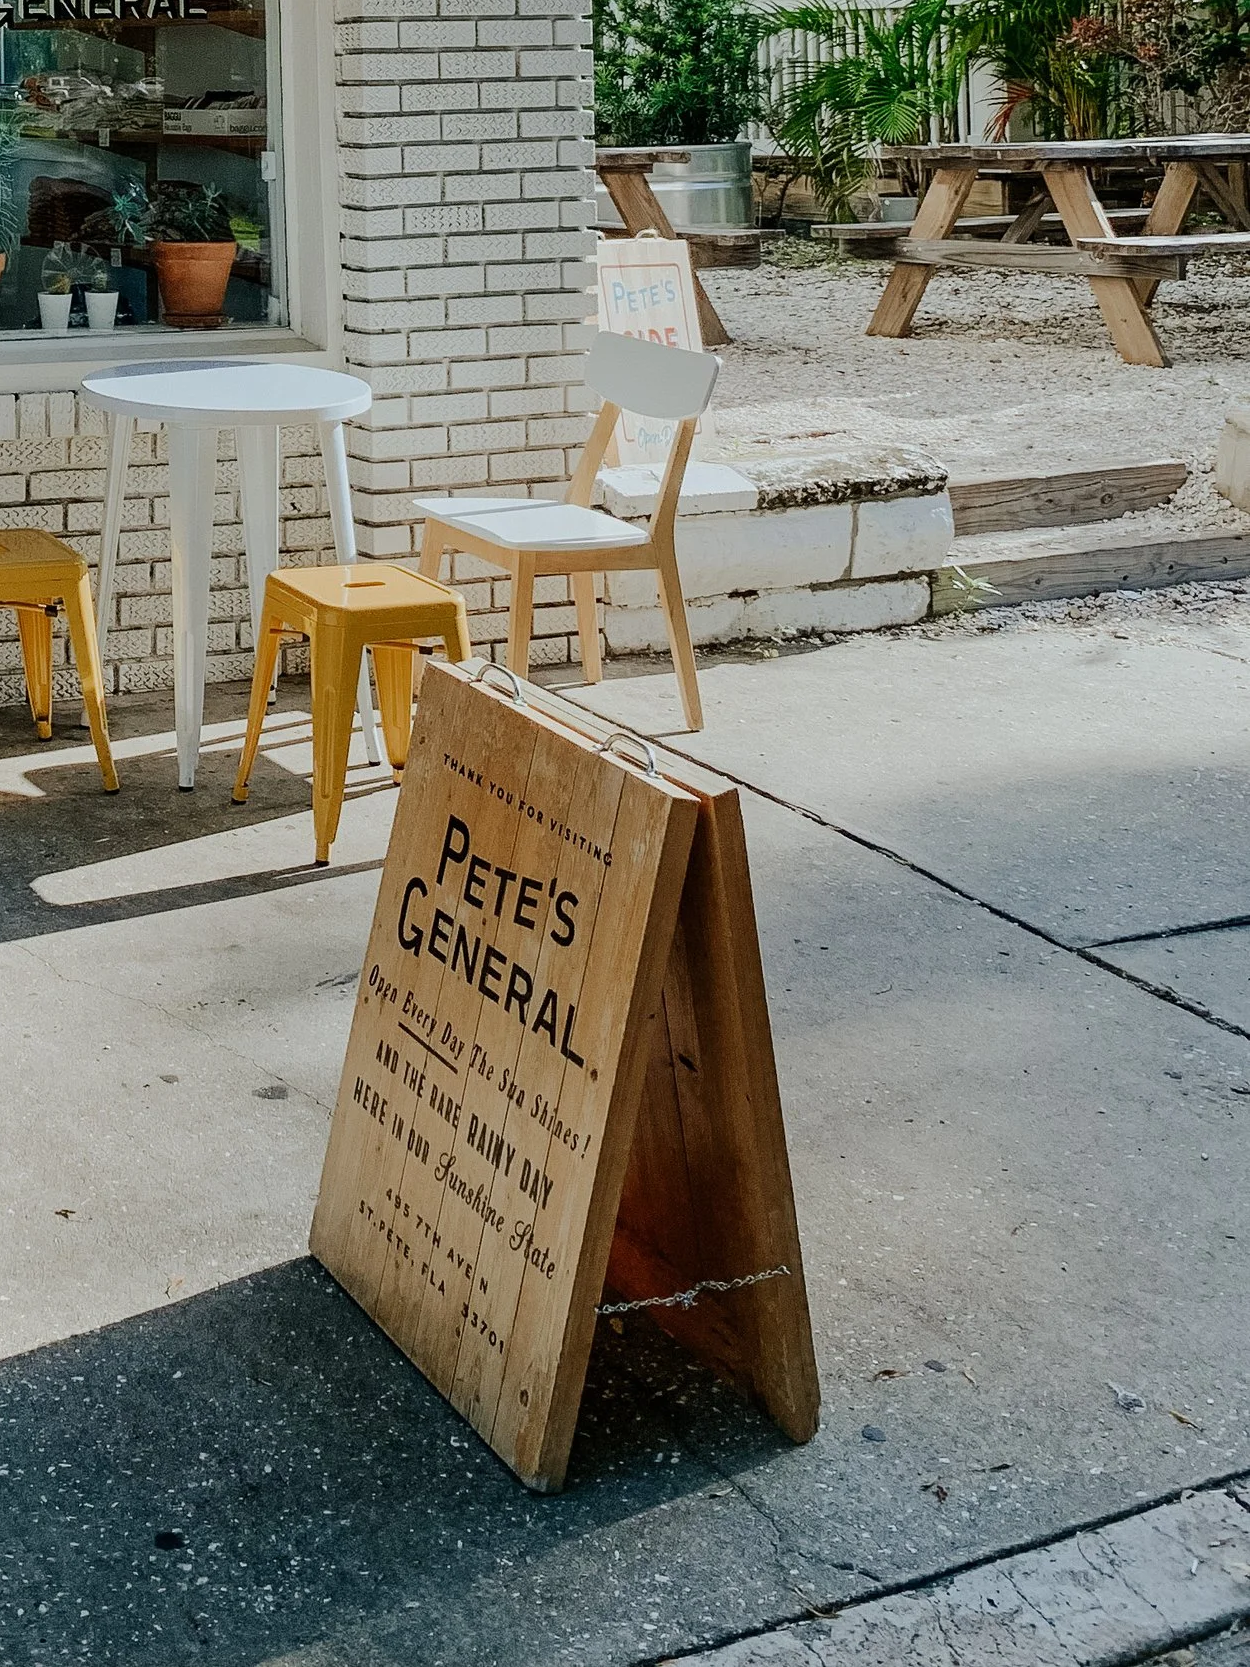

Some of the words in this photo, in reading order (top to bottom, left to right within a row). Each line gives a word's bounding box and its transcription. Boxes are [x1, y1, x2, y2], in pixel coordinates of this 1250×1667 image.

[612, 280, 676, 314] PETE'S
[443, 753, 483, 787] THANK
[489, 781, 514, 805] YOU
[518, 800, 543, 824] FOR
[550, 818, 612, 867] VISITING
[436, 814, 579, 947] PETE'S
[398, 877, 584, 1069] GENERAL
[368, 964, 398, 1004] Open
[402, 990, 438, 1038] Every
[441, 1021, 466, 1061] Day
[469, 1043, 494, 1081] The
[498, 1068, 525, 1109] Sun
[530, 1094, 591, 1159] Shines!
[376, 1039, 399, 1074] AND
[403, 1060, 427, 1098] THE
[430, 1084, 462, 1129] RARE
[467, 1112, 516, 1177] RAINY
[519, 1157, 554, 1210] DAY
[353, 1076, 388, 1126] HERE
[392, 1113, 405, 1141] IN
[407, 1128, 430, 1166] OUR
[434, 1152, 505, 1233] Sunshine
[509, 1220, 556, 1280] State
[385, 1188, 410, 1217] 495
[415, 1215, 442, 1249] 7TH
[446, 1248, 473, 1279] AVE
[479, 1277, 489, 1294] N
[421, 1262, 445, 1296] FLA
[461, 1302, 504, 1354] 33701
